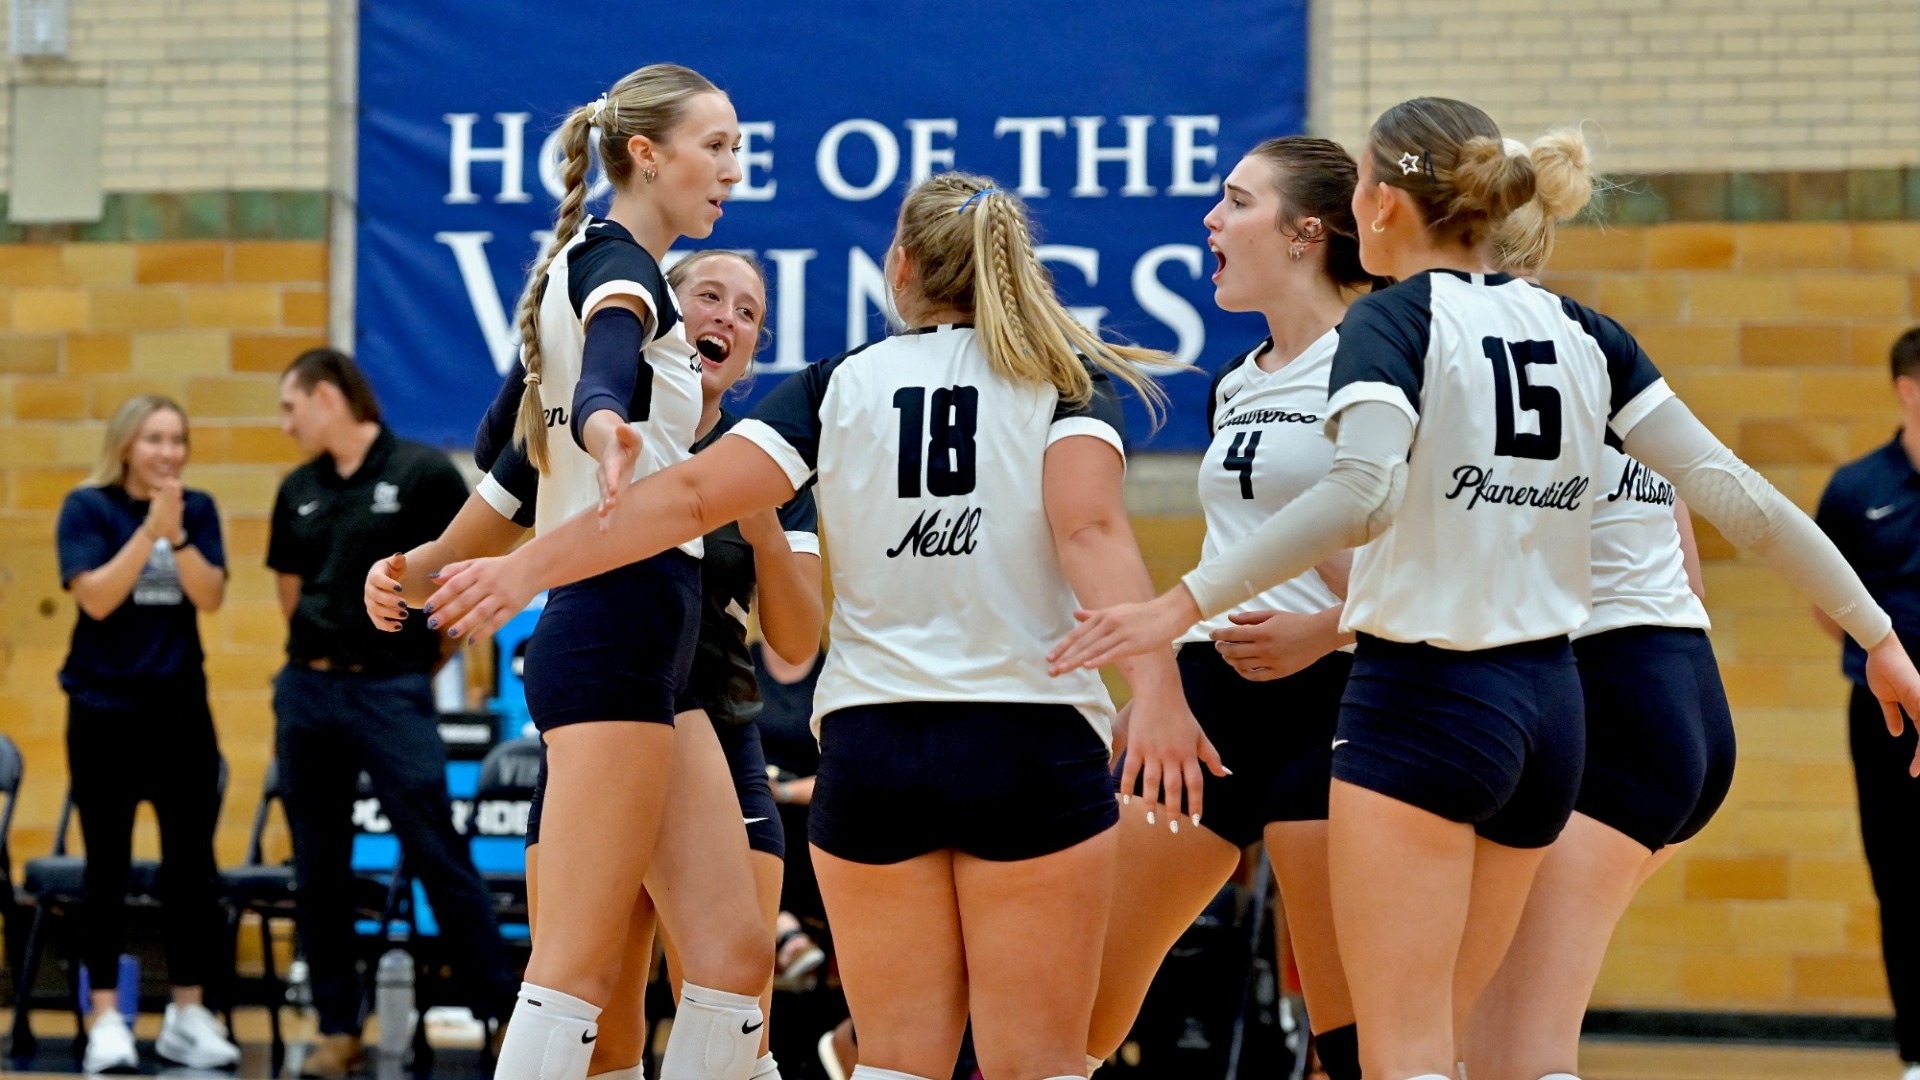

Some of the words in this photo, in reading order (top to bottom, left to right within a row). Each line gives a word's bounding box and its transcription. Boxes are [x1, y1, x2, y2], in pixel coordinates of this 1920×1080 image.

[443, 112, 777, 203] HOE
[815, 118, 958, 201] OF
[993, 114, 1221, 199] THE
[434, 230, 1206, 377] VINGS
[1482, 336, 1562, 461] 15
[893, 385, 978, 498] 18
[1223, 431, 1263, 500] 4
[1446, 465, 1590, 512] Pfanerstill
[1608, 458, 1676, 508] Nilson
[886, 506, 982, 559] Neill
